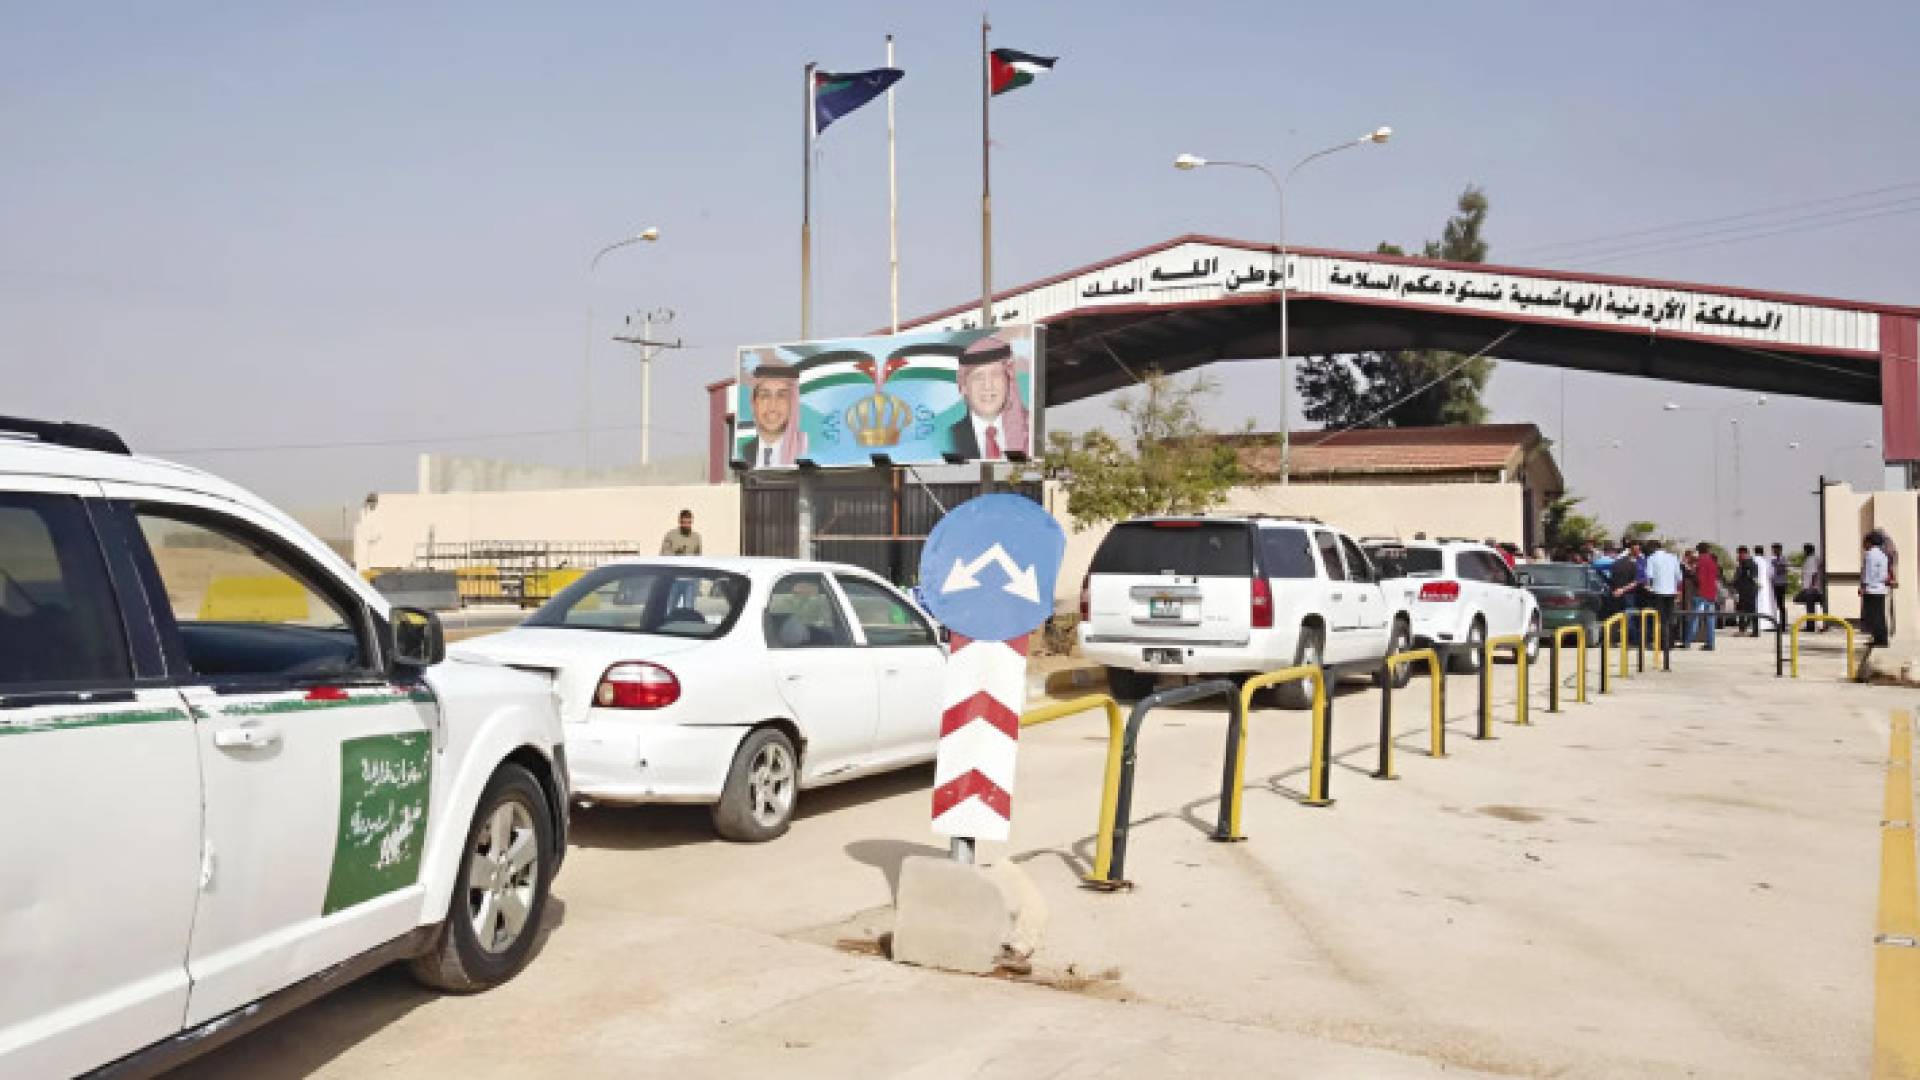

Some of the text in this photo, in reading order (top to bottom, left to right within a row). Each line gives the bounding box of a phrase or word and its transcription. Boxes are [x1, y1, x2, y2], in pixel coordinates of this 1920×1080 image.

[1150, 256, 1219, 281] الله
[1330, 265, 1399, 291] السلامة
[1082, 277, 1143, 298] الملك
[1510, 283, 1602, 316] الهاشمية
[1604, 289, 1686, 322] الأردنية
[1697, 302, 1783, 330] المملكة
